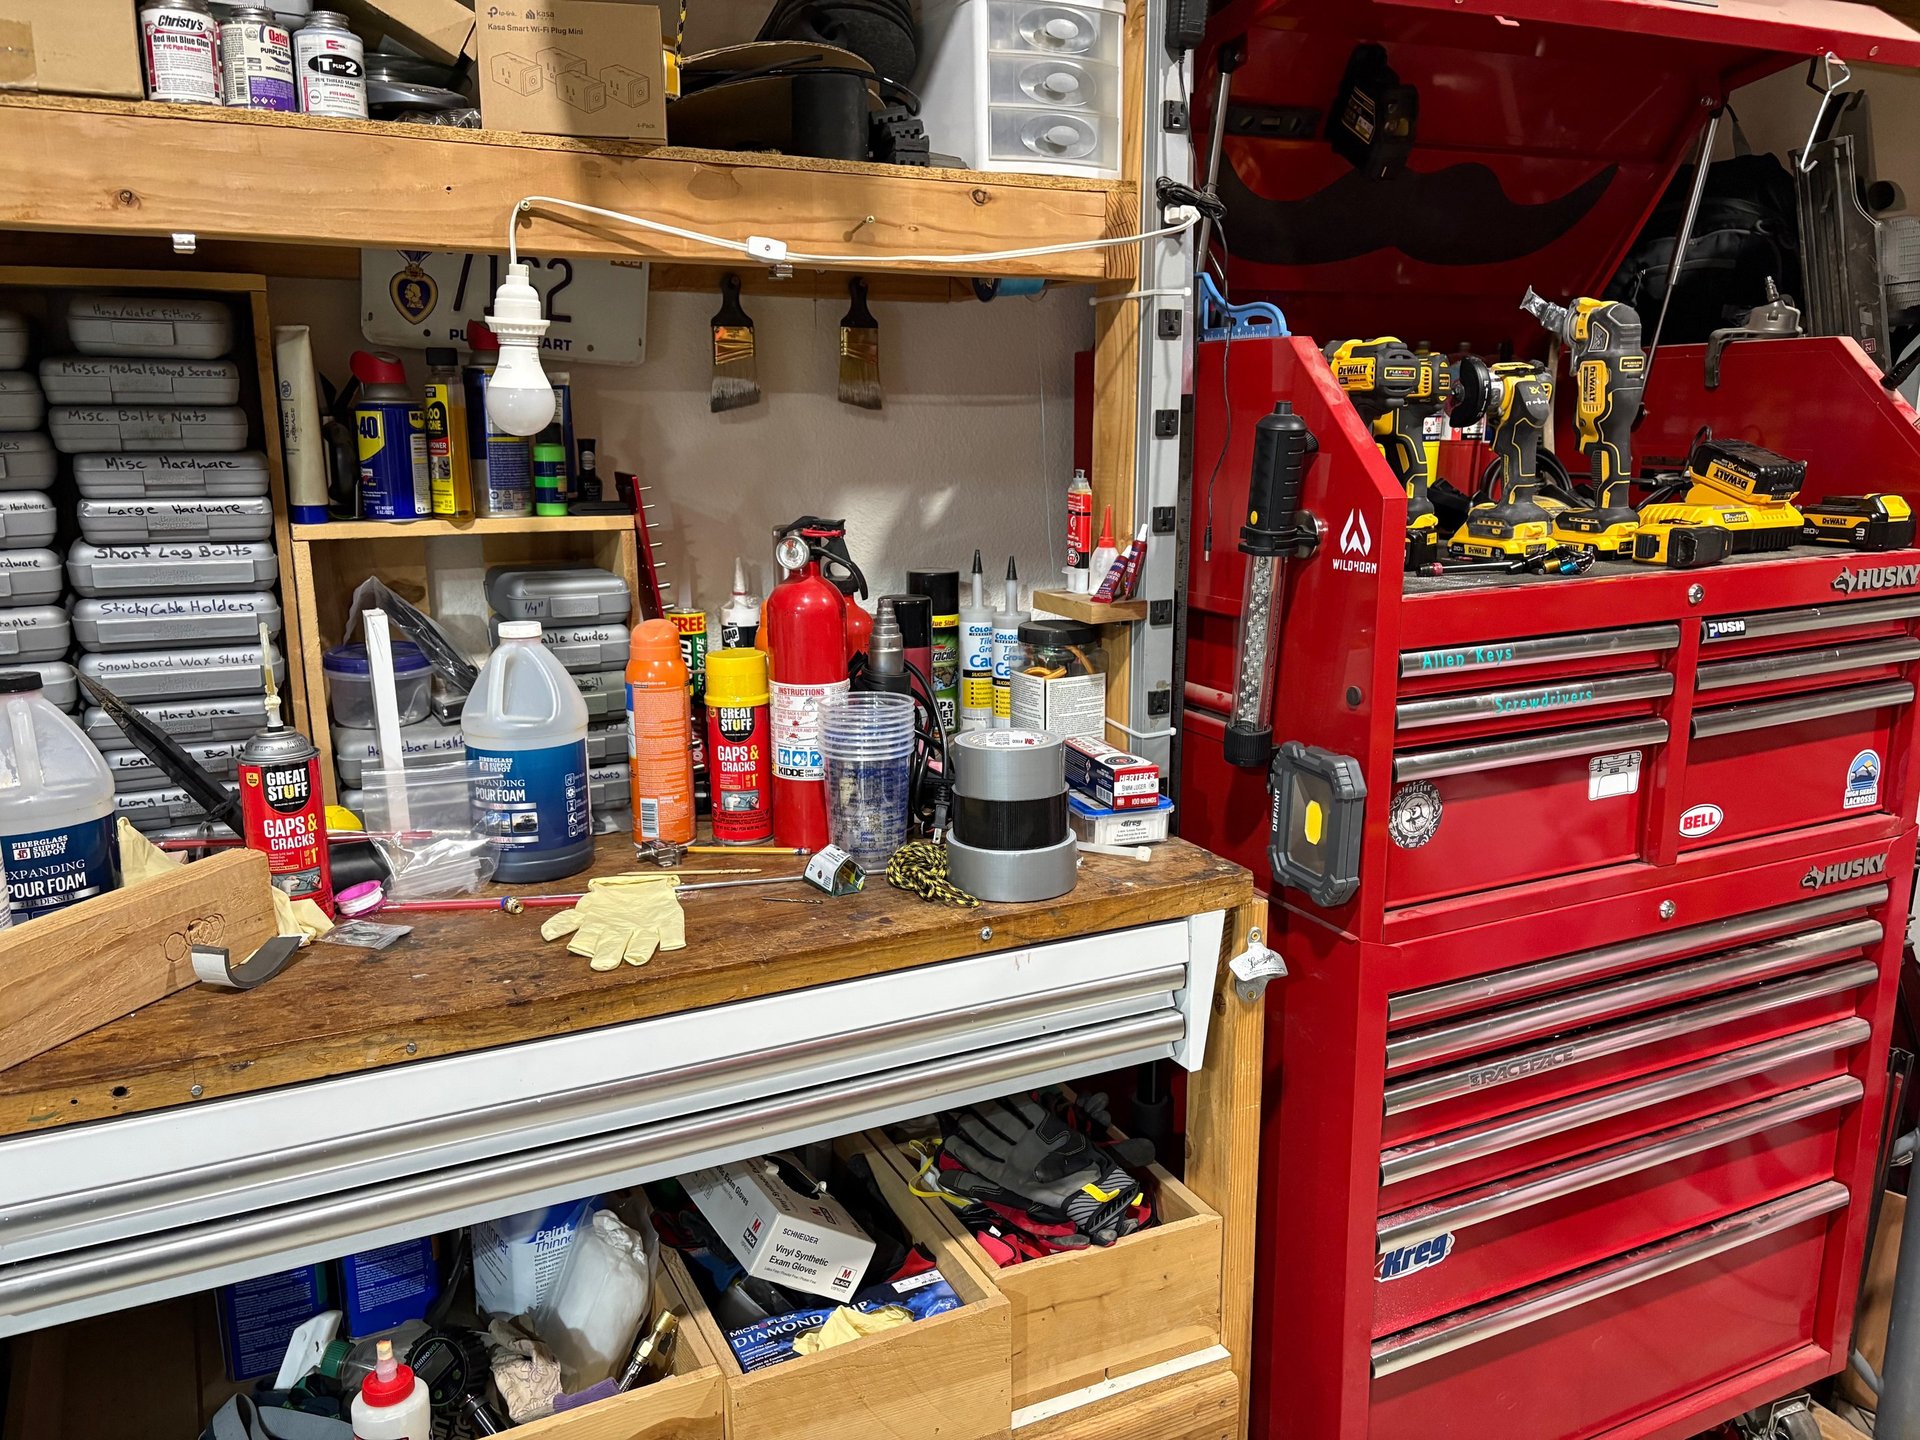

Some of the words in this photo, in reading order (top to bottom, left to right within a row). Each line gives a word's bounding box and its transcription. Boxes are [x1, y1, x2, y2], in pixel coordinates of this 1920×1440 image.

[157, 15, 204, 31] Christy's
[551, 27, 567, 35] Plug
[153, 35, 165, 43] Red
[166, 35, 178, 43] Hot
[179, 37, 195, 45] Blue
[196, 39, 210, 48] Glue
[318, 57, 333, 71] T
[345, 61, 358, 75] 2
[156, 366, 185, 378] Wood
[187, 366, 227, 377] Screws
[67, 409, 110, 423] Misc.
[170, 411, 207, 423] Nuts
[104, 457, 148, 471] Misc
[159, 456, 241, 470] Hardware
[9, 502, 49, 512] Hardware
[107, 504, 159, 517] Large
[172, 503, 246, 516] Hardware
[1855, 527, 1866, 537] 3
[94, 543, 151, 560] Short
[157, 543, 193, 559] Lag
[199, 541, 254, 557] Bolts
[0, 557, 40, 568] rdware
[1857, 564, 1920, 590] HUSKY
[100, 602, 150, 618] Sticky
[150, 602, 187, 616] Cable
[190, 599, 256, 613] Holders
[0, 617, 37, 628] aples
[671, 615, 703, 633] FREE
[1708, 620, 1746, 638] PUSH
[541, 631, 568, 645] able
[573, 630, 610, 643] Guides
[723, 628, 738, 642] DAP
[97, 655, 173, 672] Snowboard
[179, 655, 212, 668] Wax
[218, 653, 255, 666] Stuff
[969, 654, 992, 668] Cau
[1422, 651, 1465, 669] Allen
[1475, 646, 1513, 664] Keys
[777, 686, 825, 697] INSTRUCTIONS
[1494, 688, 1594, 715] Screwdrivers
[159, 708, 241, 721] Hardware
[720, 707, 753, 721] GREAT
[721, 717, 753, 731] STUFF
[717, 745, 750, 762] GAPS
[750, 744, 760, 760] &
[119, 756, 150, 767] Lon
[721, 760, 757, 773] CRACKS
[266, 767, 306, 787] GREAT
[590, 770, 620, 780] chors
[778, 765, 805, 777] KIDDE
[1119, 771, 1156, 783] HERTER'S
[267, 781, 309, 802] STUFF
[475, 787, 496, 801] POUR
[497, 788, 526, 802] FOAM
[118, 797, 156, 809] Long
[1845, 795, 1876, 805] LACROSSE
[1272, 787, 1281, 832] DEFIANT
[263, 816, 305, 839] GAPS
[307, 813, 319, 831] &
[1682, 811, 1716, 831] BELL
[12, 834, 69, 850] FIBERGLASS
[33, 841, 68, 853] SUPPLY
[270, 833, 316, 851] CRACKS
[33, 847, 66, 859] DEPOT
[5, 858, 86, 881] EXPANDING
[1825, 853, 1888, 884] HUSKY
[7, 880, 46, 899] POUR
[47, 871, 88, 895] FOAM
[1479, 1047, 1575, 1085] RACEFACE
[735, 1186, 749, 1207] Gloves
[536, 1222, 571, 1241] Paint
[782, 1228, 819, 1245] SCHNEIDER
[535, 1234, 572, 1253] Thinne
[775, 1243, 795, 1257] Vinyl
[794, 1250, 830, 1267] Synthetic
[1381, 1233, 1449, 1280] Kreg
[769, 1255, 791, 1269] Exam
[791, 1262, 817, 1276] Gloves
[842, 1268, 852, 1279] M
[833, 1278, 851, 1288] BLACK
[729, 1313, 798, 1338] MICROFLEX
[733, 1315, 823, 1348] DIAMOND
